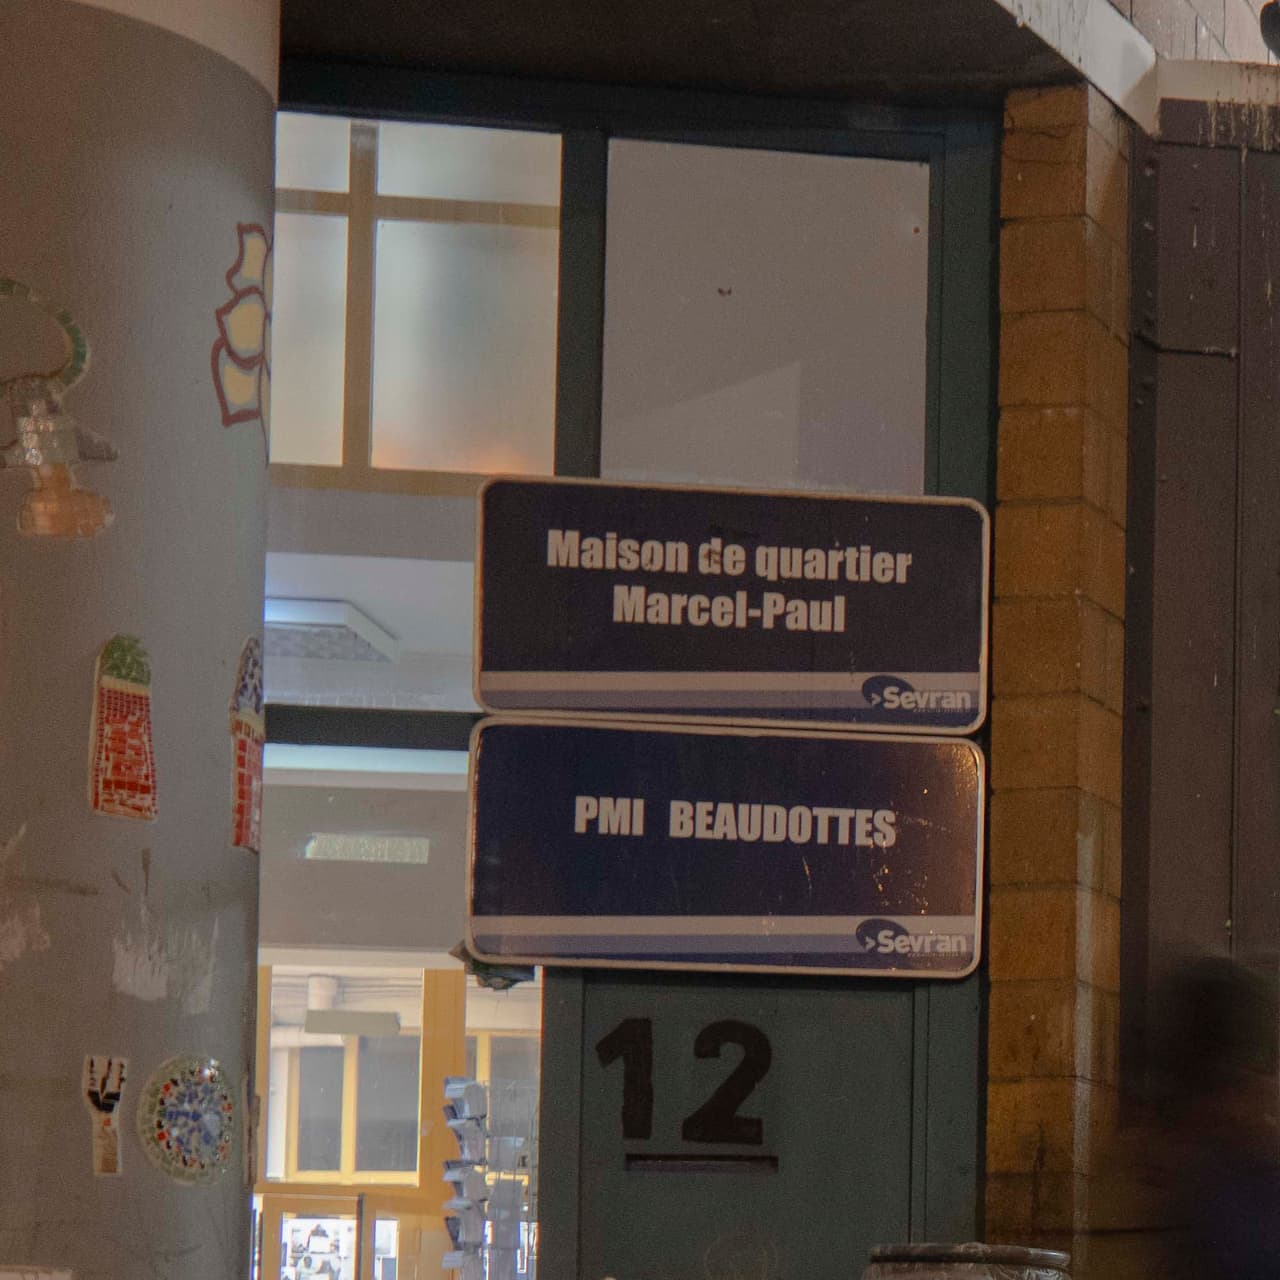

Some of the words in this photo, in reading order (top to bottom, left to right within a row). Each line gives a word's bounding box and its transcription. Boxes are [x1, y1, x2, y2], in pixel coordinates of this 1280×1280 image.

[547, 529, 690, 574] Maison
[698, 537, 746, 575] de
[755, 545, 912, 584] quartier
[613, 585, 846, 632] Marcel-Paul
[884, 686, 971, 710] Sevran
[574, 795, 645, 836] PMI
[668, 800, 898, 848] BEAUDOTTES
[877, 929, 967, 954] Sevran
[595, 1018, 772, 1145] 12
